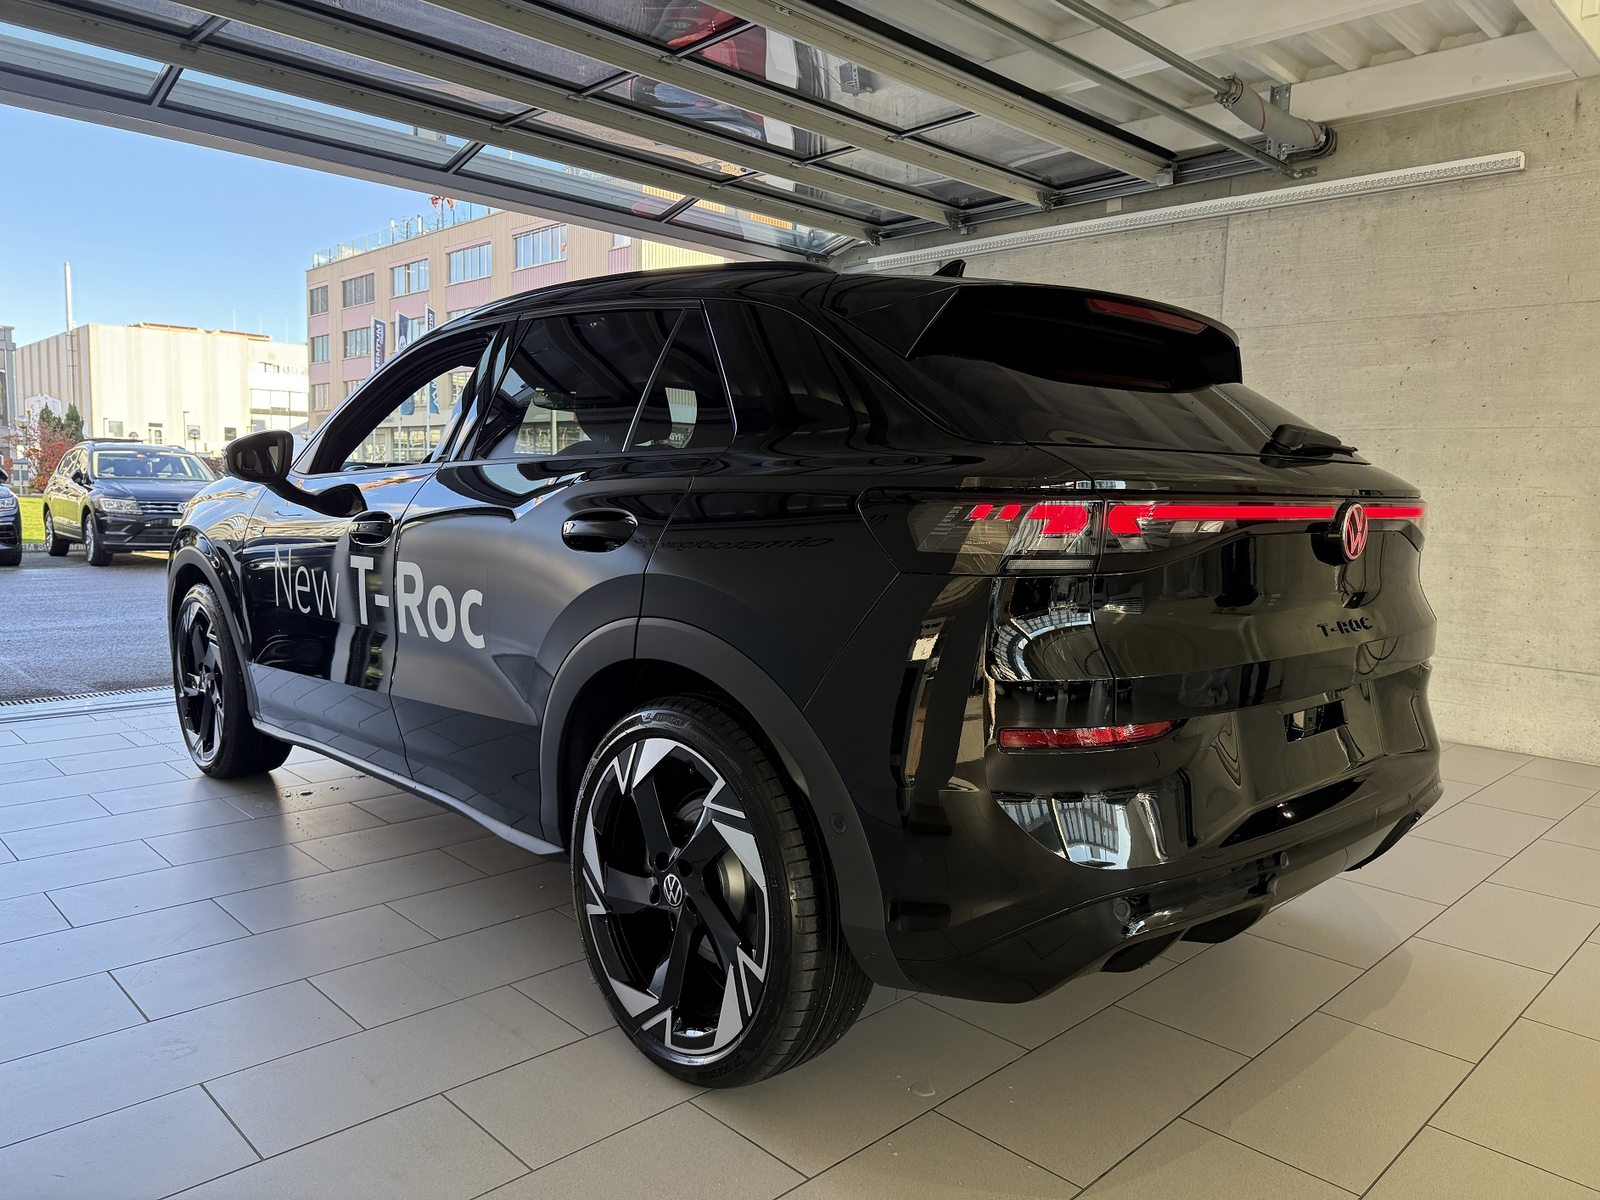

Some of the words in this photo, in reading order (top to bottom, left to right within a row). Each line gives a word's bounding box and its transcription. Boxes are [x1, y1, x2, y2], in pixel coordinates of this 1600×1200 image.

[274, 544, 340, 619] New
[350, 554, 486, 649] T-Roc
[1317, 617, 1373, 637] T-ROC
